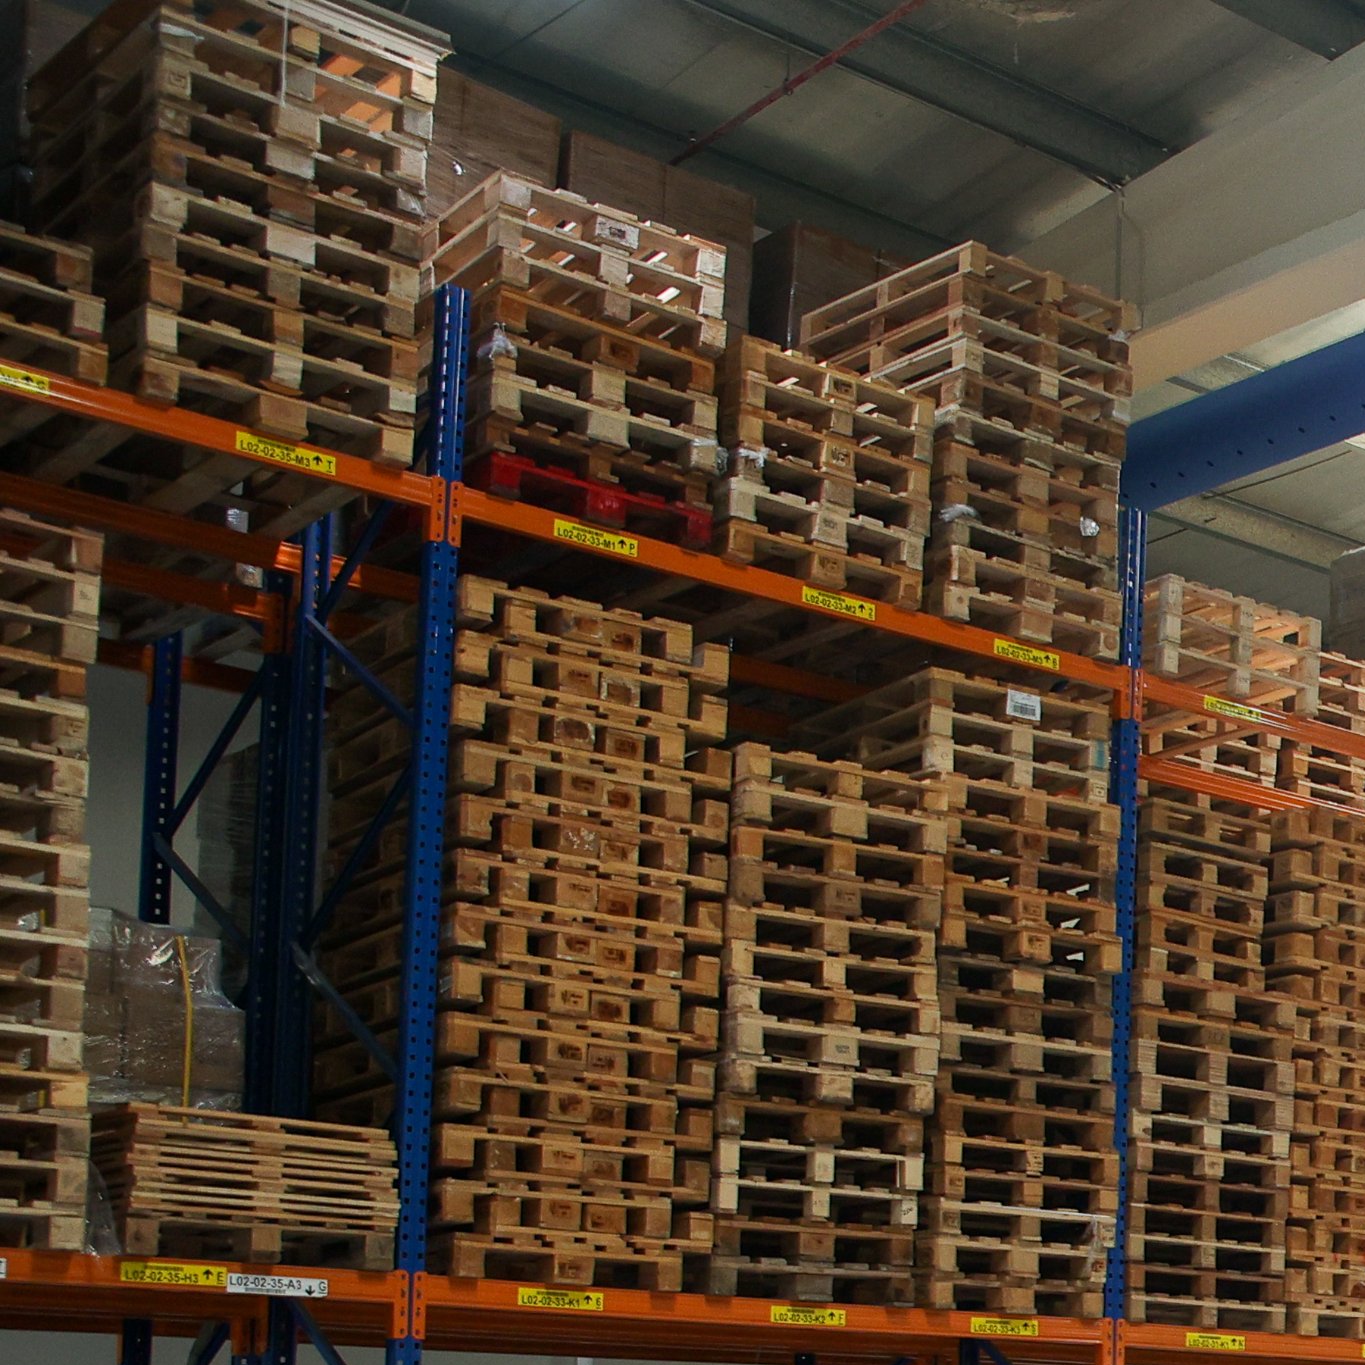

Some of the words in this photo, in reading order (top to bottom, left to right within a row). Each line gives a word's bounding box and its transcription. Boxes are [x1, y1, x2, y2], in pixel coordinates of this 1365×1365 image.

[240, 438, 311, 468] L02-02-35-M3
[557, 527, 616, 550] L02-02-33-M1
[125, 1270, 199, 1284] L02-02-35-H3
[217, 1272, 223, 1283] E
[229, 1275, 302, 1290] L02-02-35-A3
[318, 1282, 326, 1292] G
[521, 1295, 580, 1307] L02-02-33-K1
[774, 1312, 826, 1324] L02-02-33-K2
